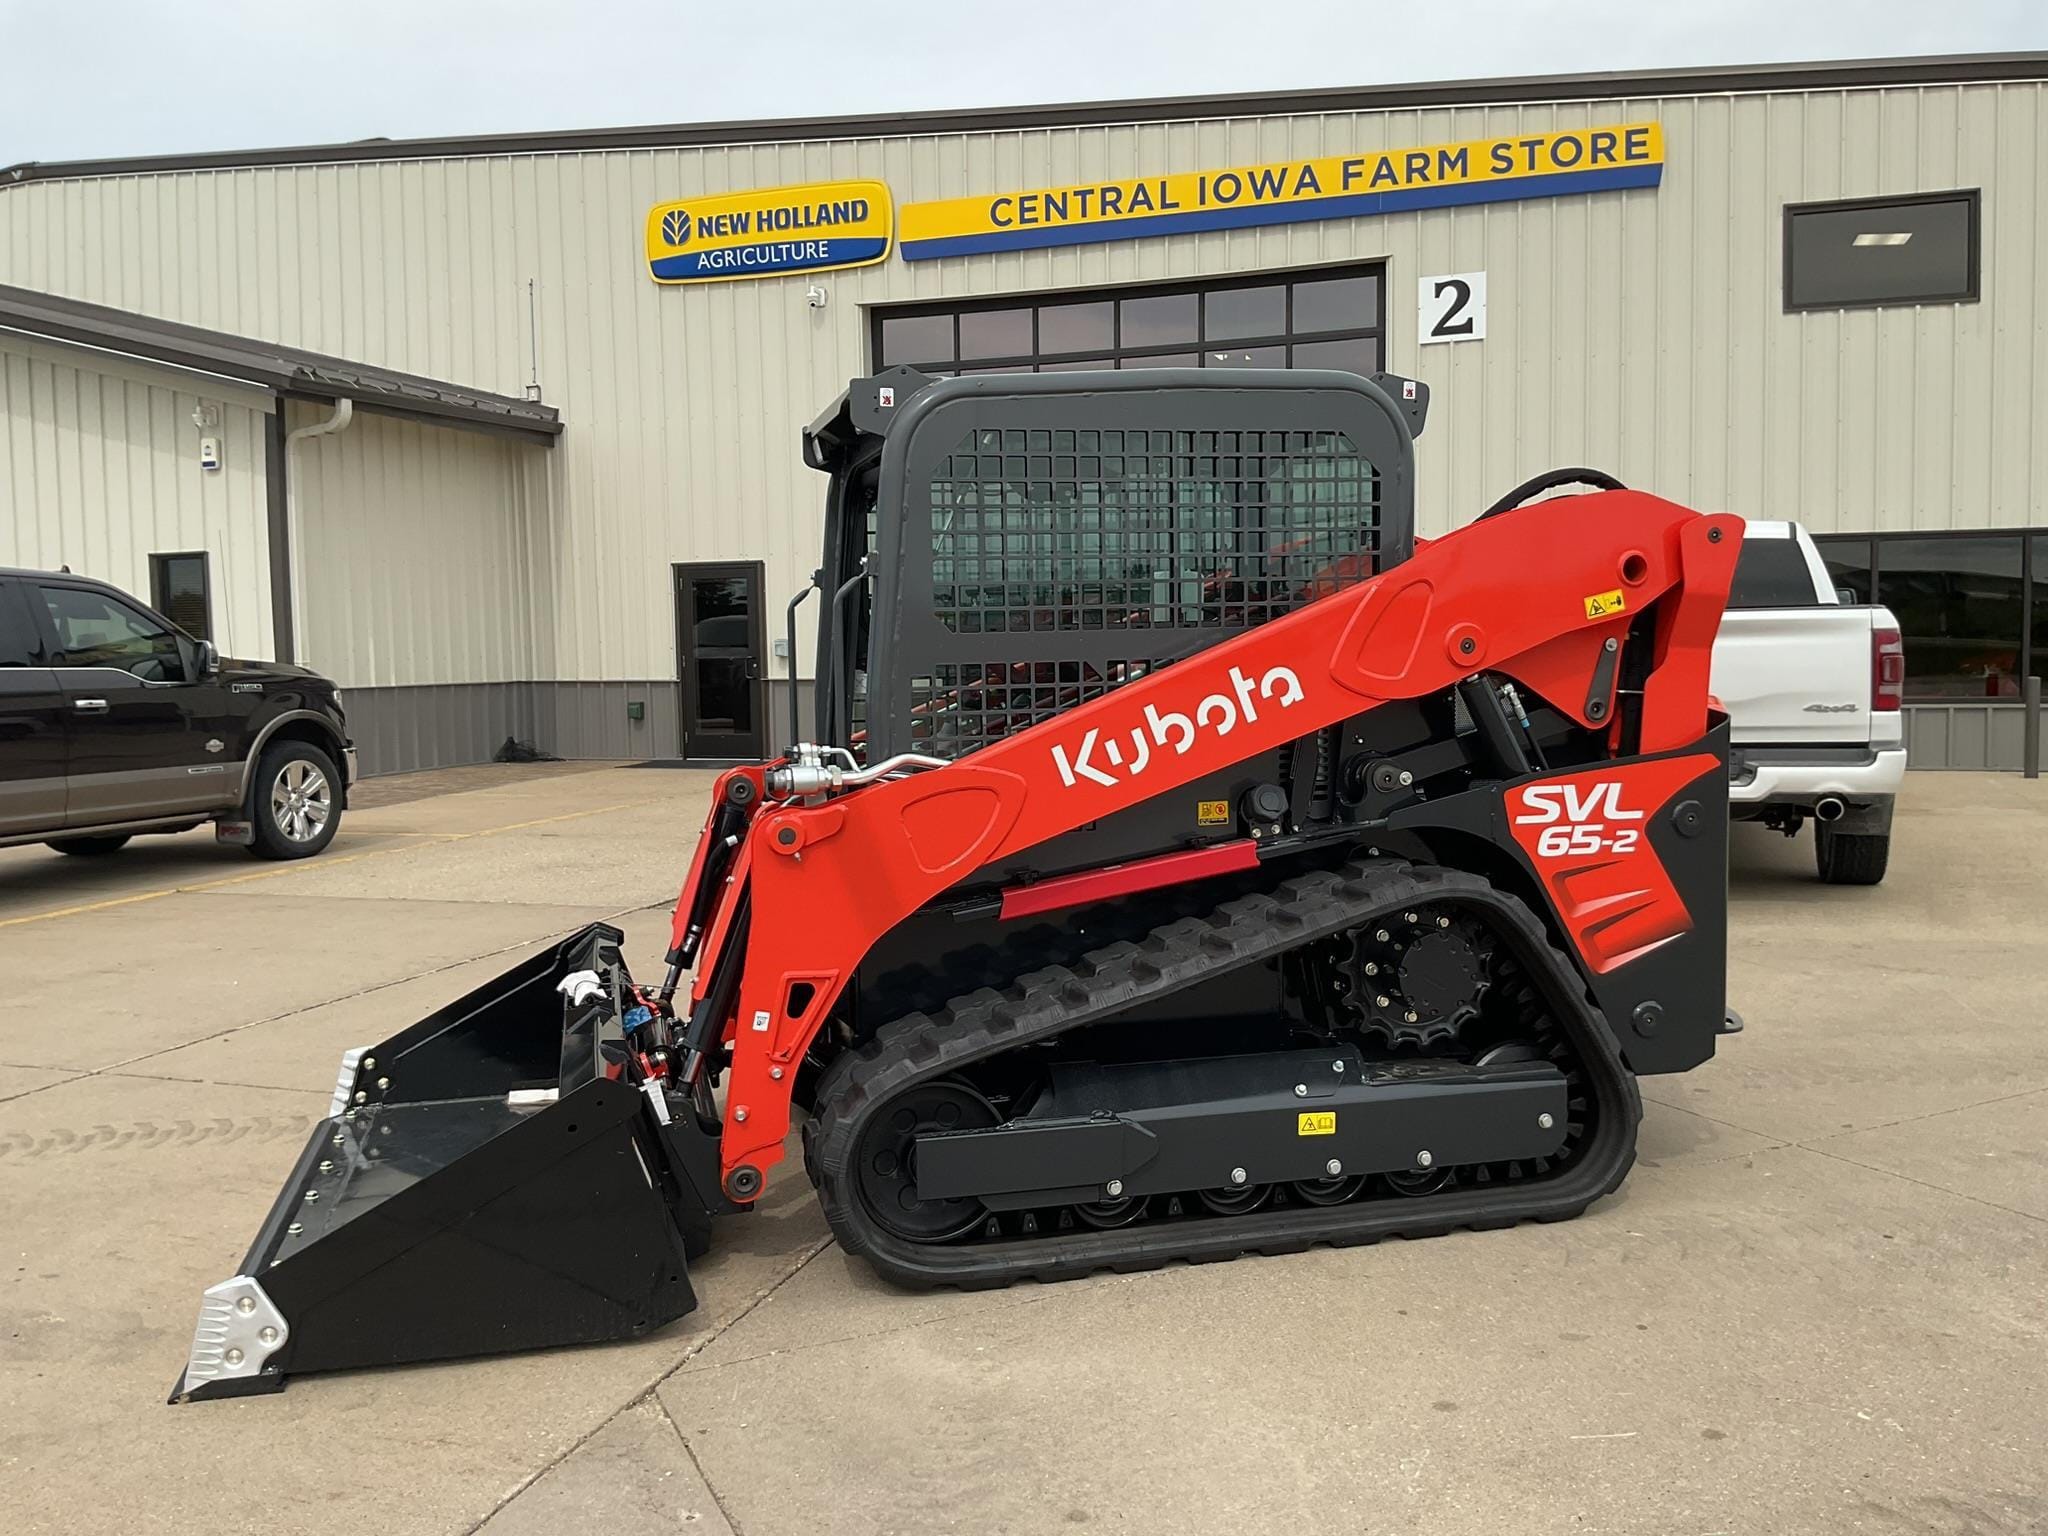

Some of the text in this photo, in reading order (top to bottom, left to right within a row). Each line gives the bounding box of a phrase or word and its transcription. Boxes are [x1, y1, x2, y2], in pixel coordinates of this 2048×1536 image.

[990, 127, 1649, 227] CENTRAL IOWA FARM STORE
[698, 199, 869, 238] NEW HOLLAND
[697, 240, 829, 270] AGRICULTURE
[1430, 279, 1474, 337] 2
[1051, 665, 1305, 788] Kubota
[1515, 782, 1644, 825] SVL
[1537, 824, 1639, 857] 65-2
